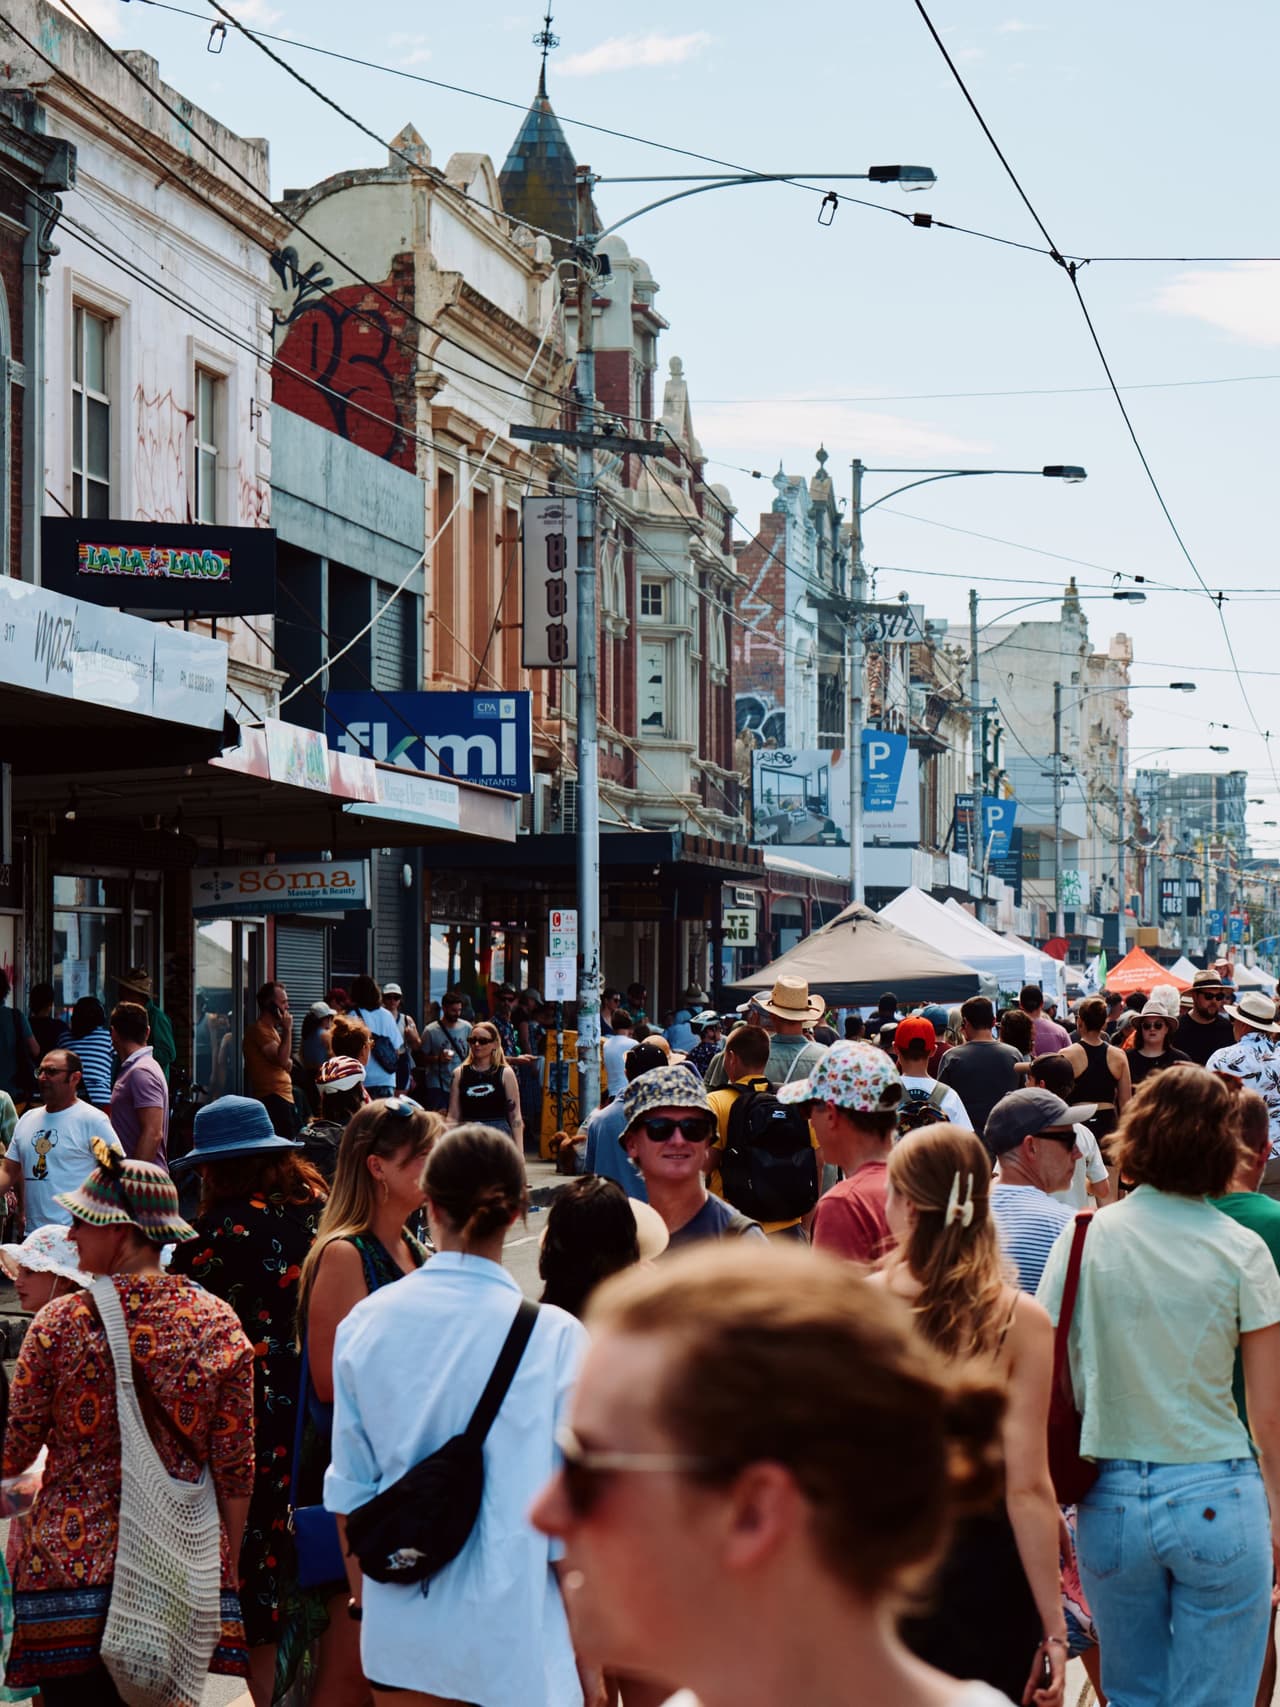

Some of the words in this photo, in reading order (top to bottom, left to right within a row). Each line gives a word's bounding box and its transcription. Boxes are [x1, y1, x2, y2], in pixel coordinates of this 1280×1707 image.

[168, 549, 223, 577] LAND
[4, 622, 15, 643] 317
[476, 703, 496, 713] CPA
[869, 741, 890, 770] P
[987, 806, 1004, 828] P
[239, 868, 356, 894] Sóma
[287, 890, 320, 898] Massage
[330, 886, 356, 896] Beauty
[727, 915, 749, 927] TI
[1232, 921, 1239, 931] P
[727, 928, 749, 940] NO
